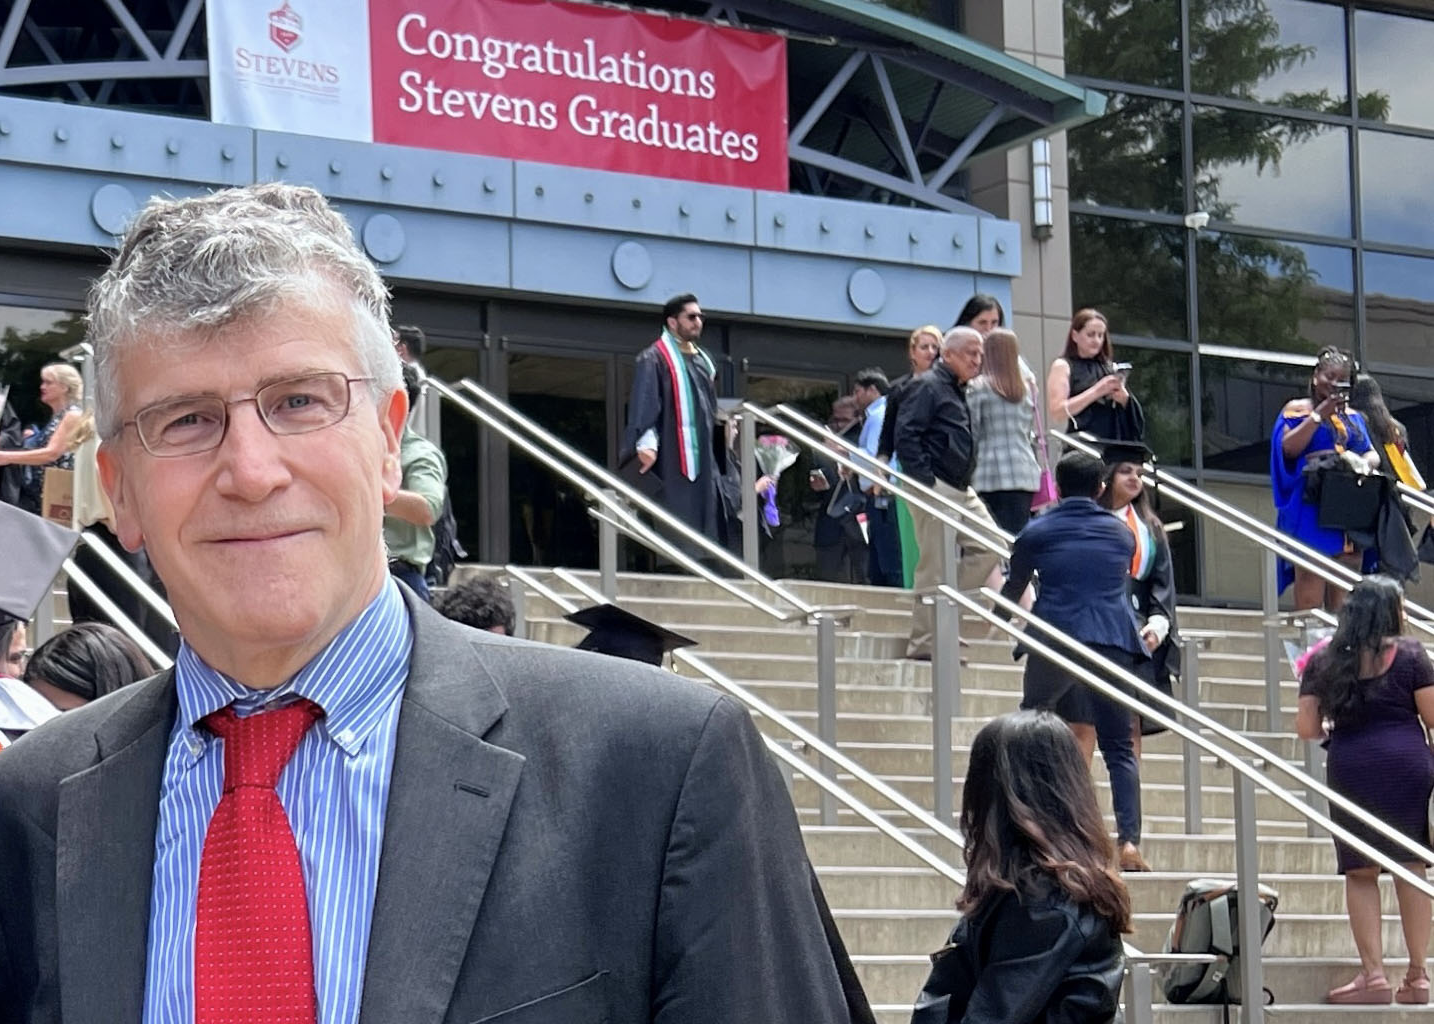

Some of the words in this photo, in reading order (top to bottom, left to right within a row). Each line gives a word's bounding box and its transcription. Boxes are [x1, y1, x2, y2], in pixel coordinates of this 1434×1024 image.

[235, 47, 340, 84] STEVENS
[397, 13, 716, 99] Congratulations
[399, 70, 557, 130] Stevens
[569, 94, 759, 163] Graduates
